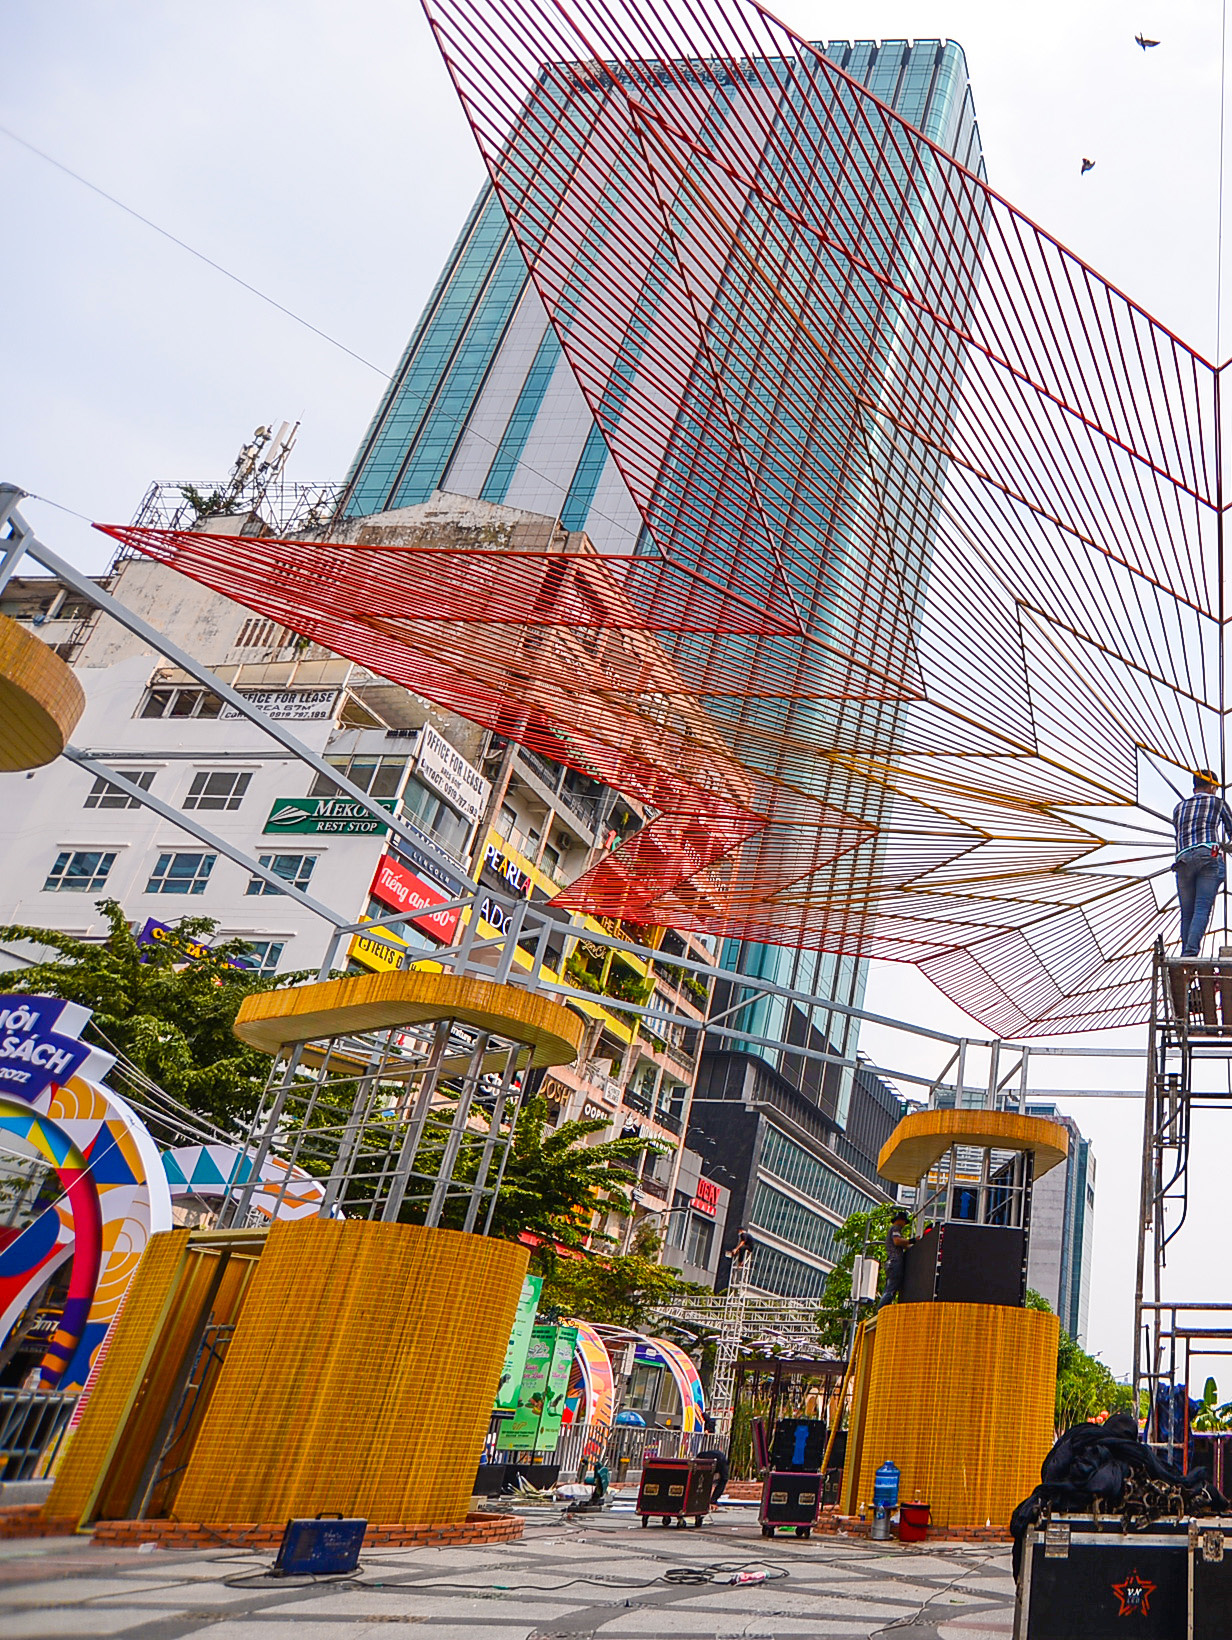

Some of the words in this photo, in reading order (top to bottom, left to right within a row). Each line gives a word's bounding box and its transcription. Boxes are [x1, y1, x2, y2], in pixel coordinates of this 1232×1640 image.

[242, 693, 273, 704] FFICE
[274, 693, 297, 704] FOR
[299, 692, 334, 703] LEASE
[426, 729, 451, 763] OFFICE
[449, 755, 464, 777] FOR
[462, 765, 484, 796] LEASE
[316, 822, 346, 832] REST
[347, 822, 378, 832] STOP
[411, 850, 451, 884] LINCOLN
[483, 842, 531, 897] PEARLA
[380, 866, 410, 904] Tiếng
[371, 939, 396, 965] IELTS
[0, 1033, 75, 1075] SÁCH
[539, 1078, 571, 1107] JOSH
